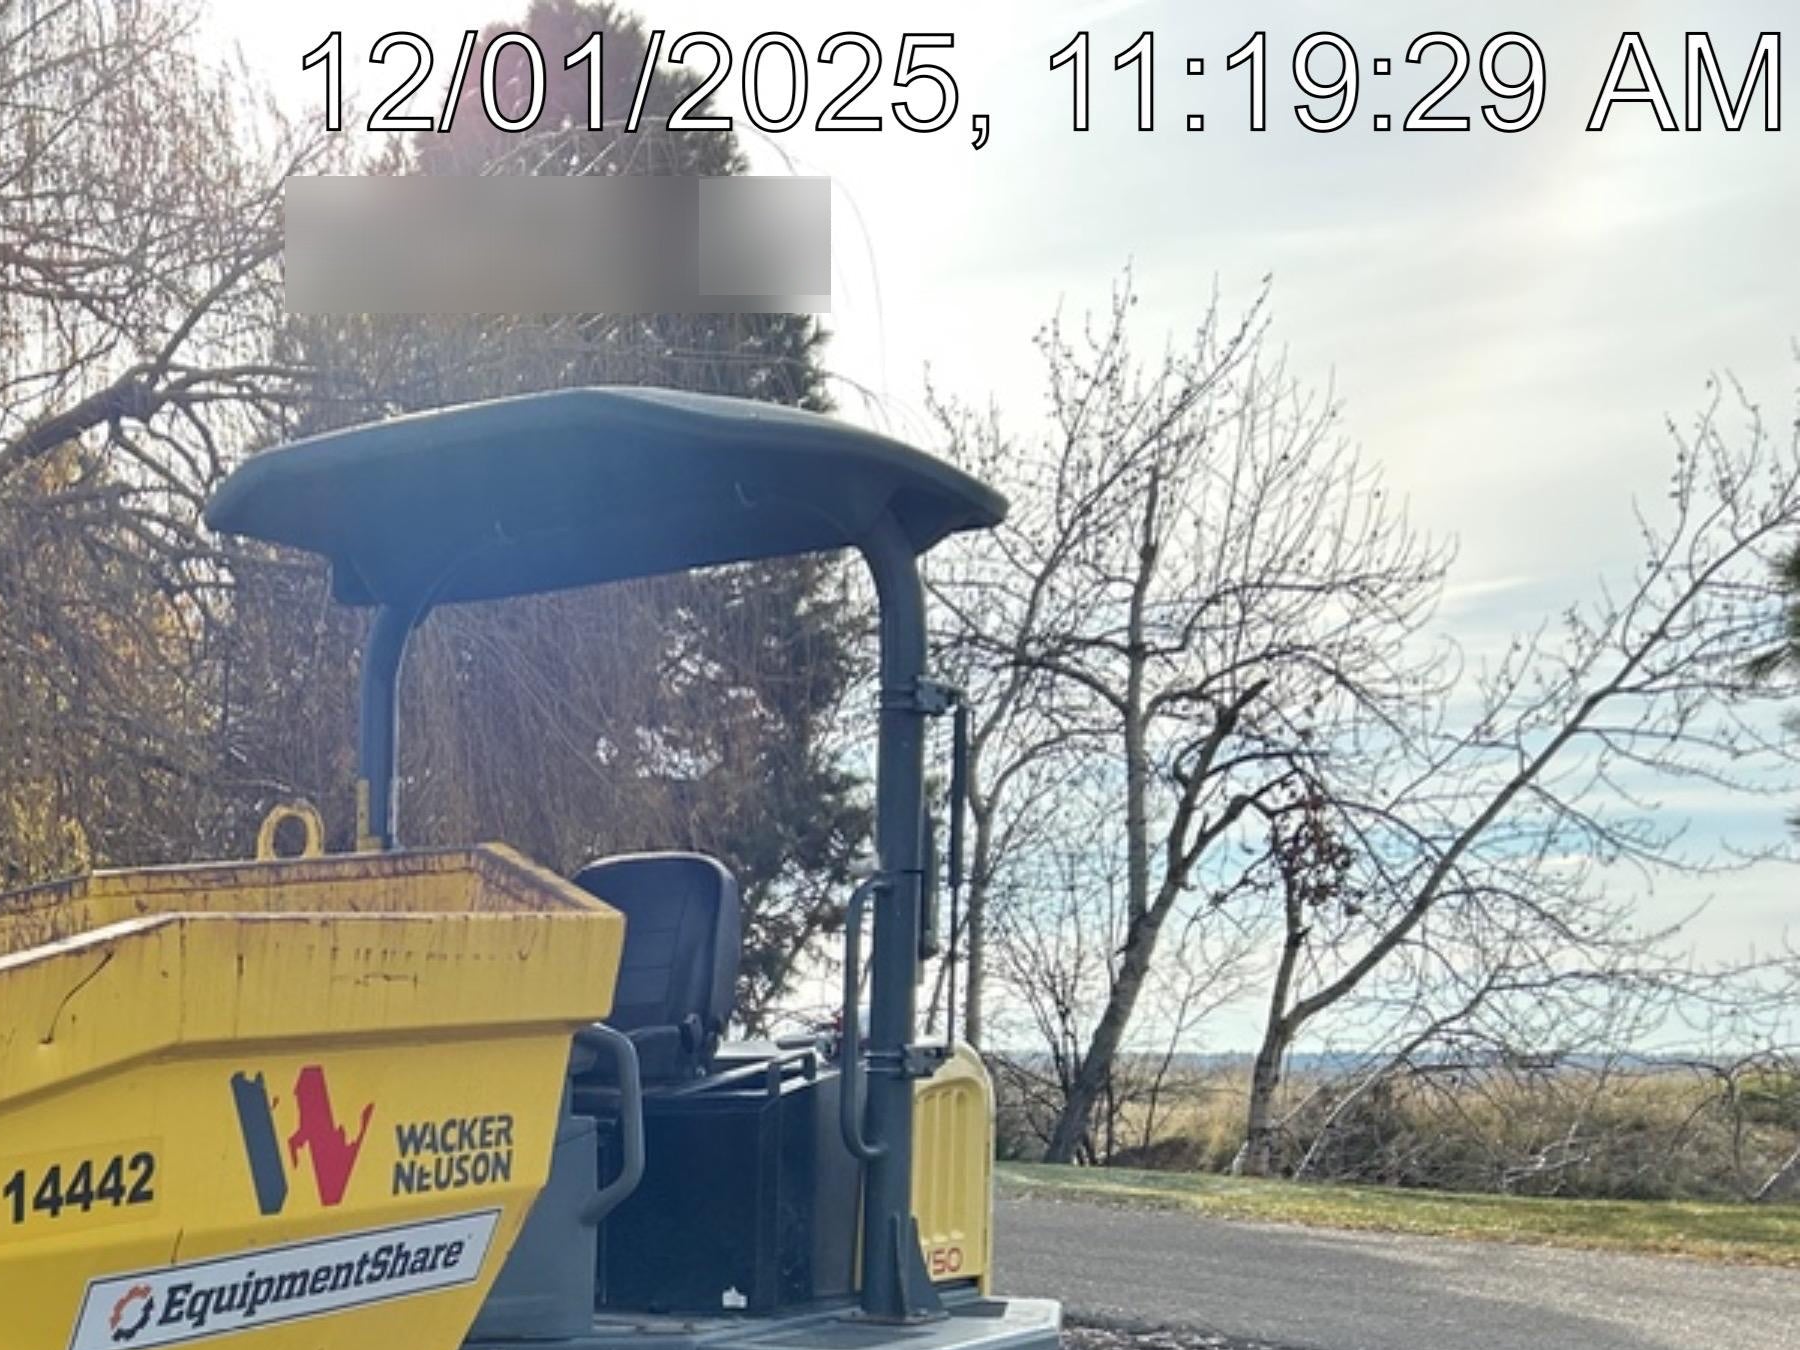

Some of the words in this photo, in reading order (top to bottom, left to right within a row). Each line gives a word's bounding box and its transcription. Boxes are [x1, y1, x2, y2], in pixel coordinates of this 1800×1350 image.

[395, 1114, 514, 1157] WACKER
[393, 1150, 513, 1196] NEUSON
[928, 1247, 964, 1275] 50
[157, 1240, 466, 1328] EquipmentShare
